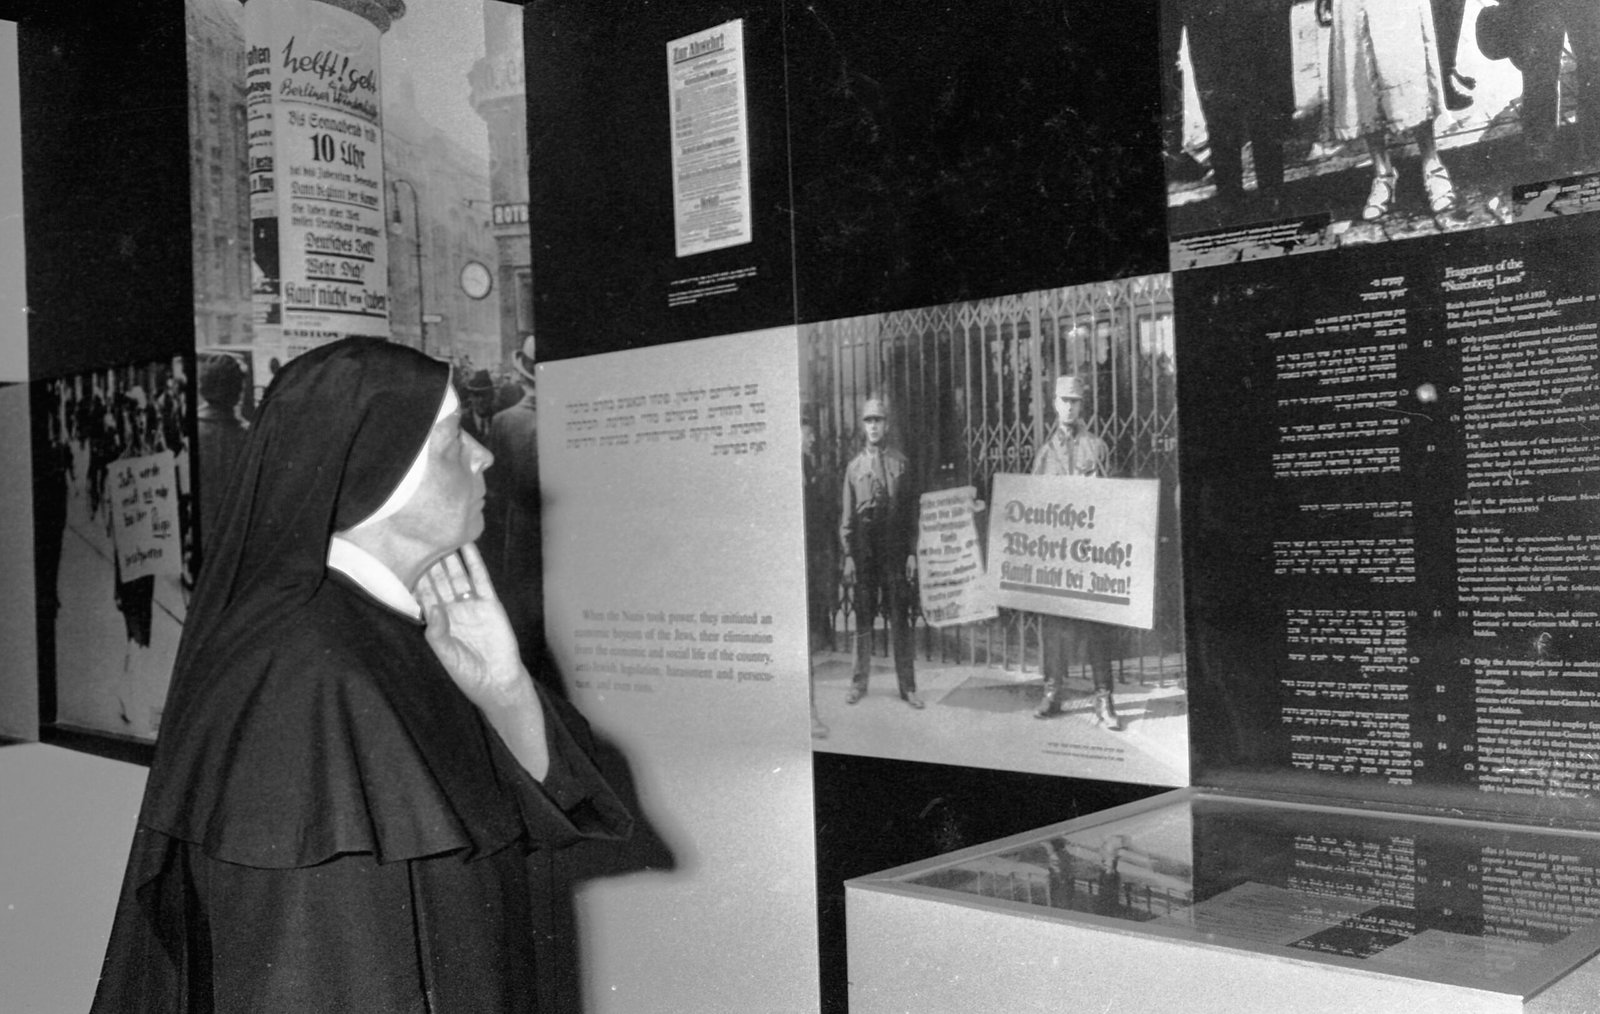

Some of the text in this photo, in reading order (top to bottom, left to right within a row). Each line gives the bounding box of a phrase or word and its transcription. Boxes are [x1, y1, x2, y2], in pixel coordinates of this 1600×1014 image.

[309, 133, 365, 169] 10 Uhr
[1445, 258, 1525, 279] Fragments of the
[1541, 326, 1562, 334] blood
[1004, 500, 1096, 530] Deutsche!
[1002, 531, 1133, 572] Wehrt Euch!
[1034, 566, 1062, 588] nicht
[1065, 568, 1083, 590] bei
[1087, 571, 1132, 597] Juden!
